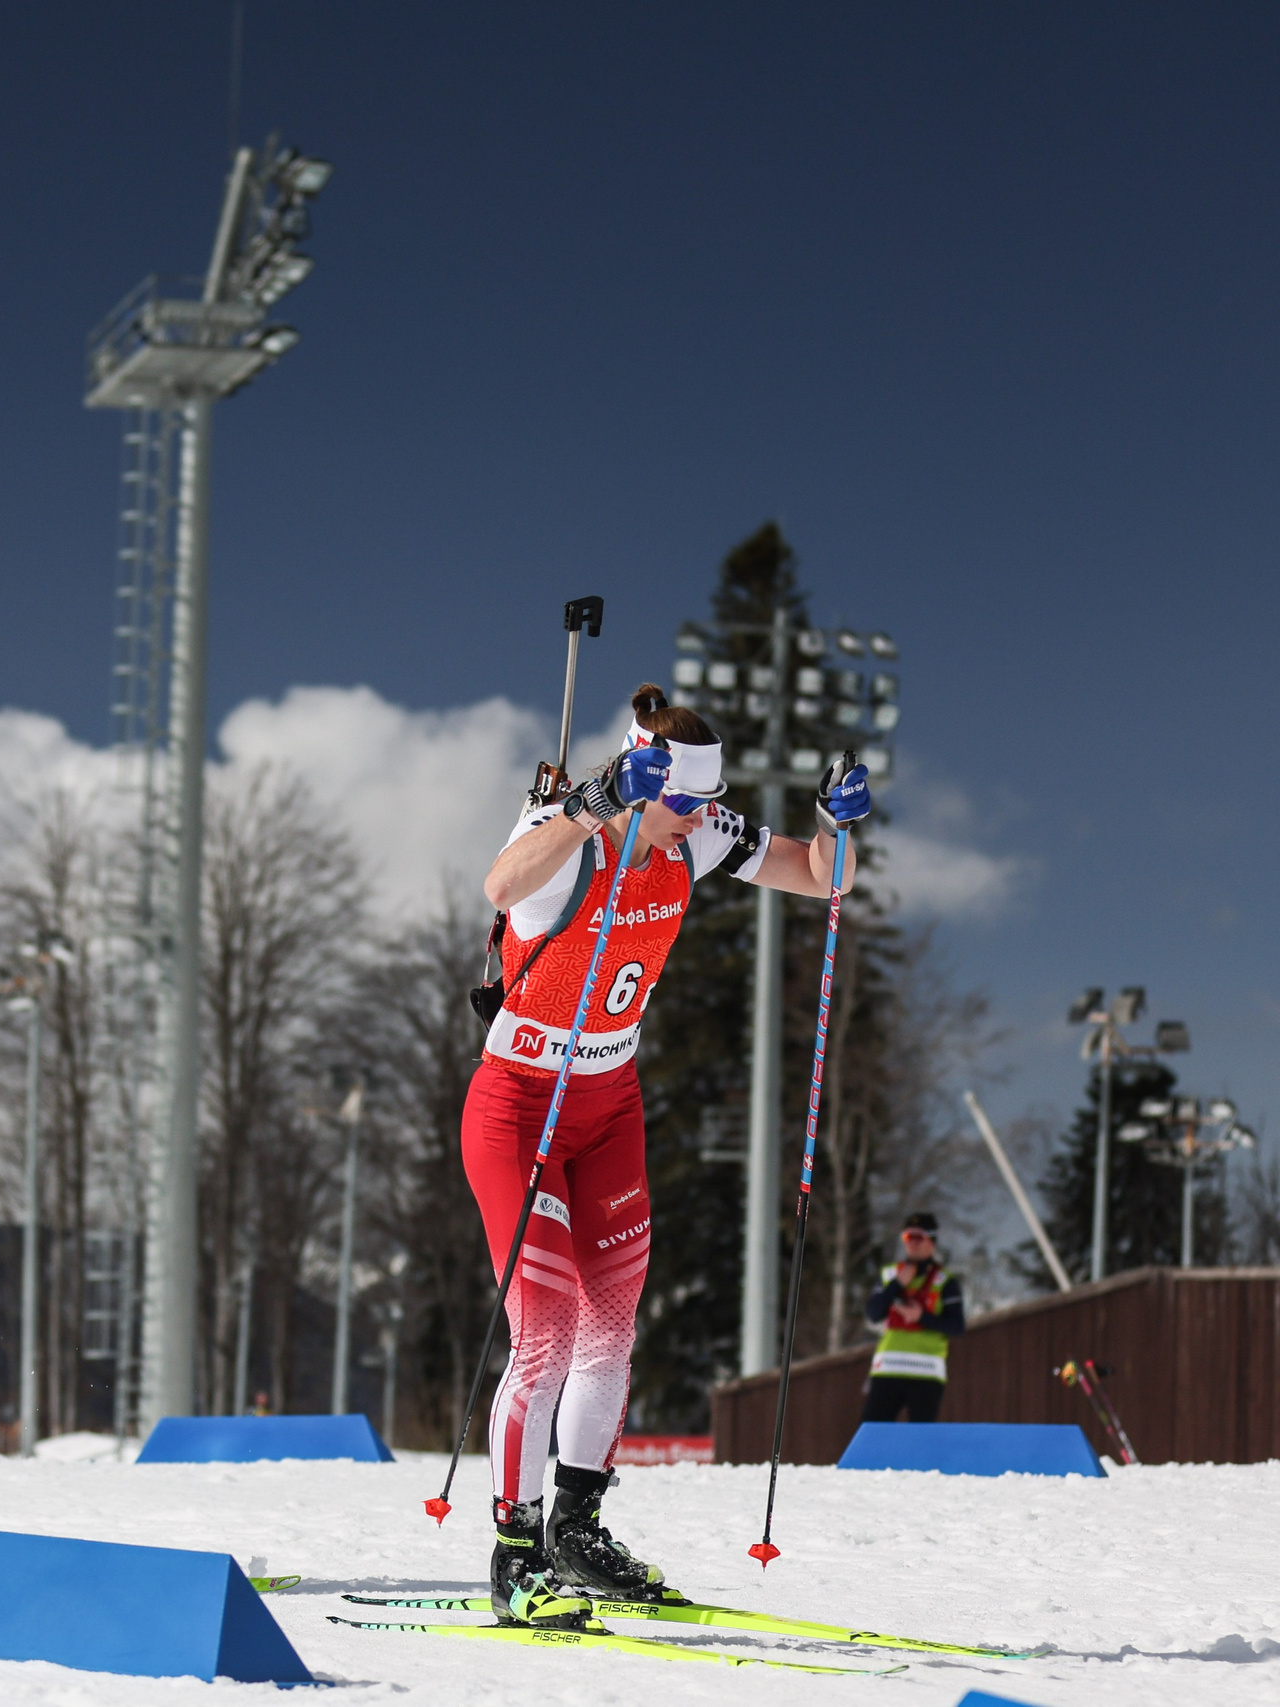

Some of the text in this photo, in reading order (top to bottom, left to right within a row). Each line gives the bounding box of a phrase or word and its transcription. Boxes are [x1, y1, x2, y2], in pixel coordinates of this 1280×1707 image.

[648, 899, 683, 922] Банк
[605, 961, 644, 1016] 6
[610, 1187, 641, 1210] Альфа Банк
[599, 1603, 660, 1616] FISCHER
[532, 1631, 582, 1644] FISCHER
